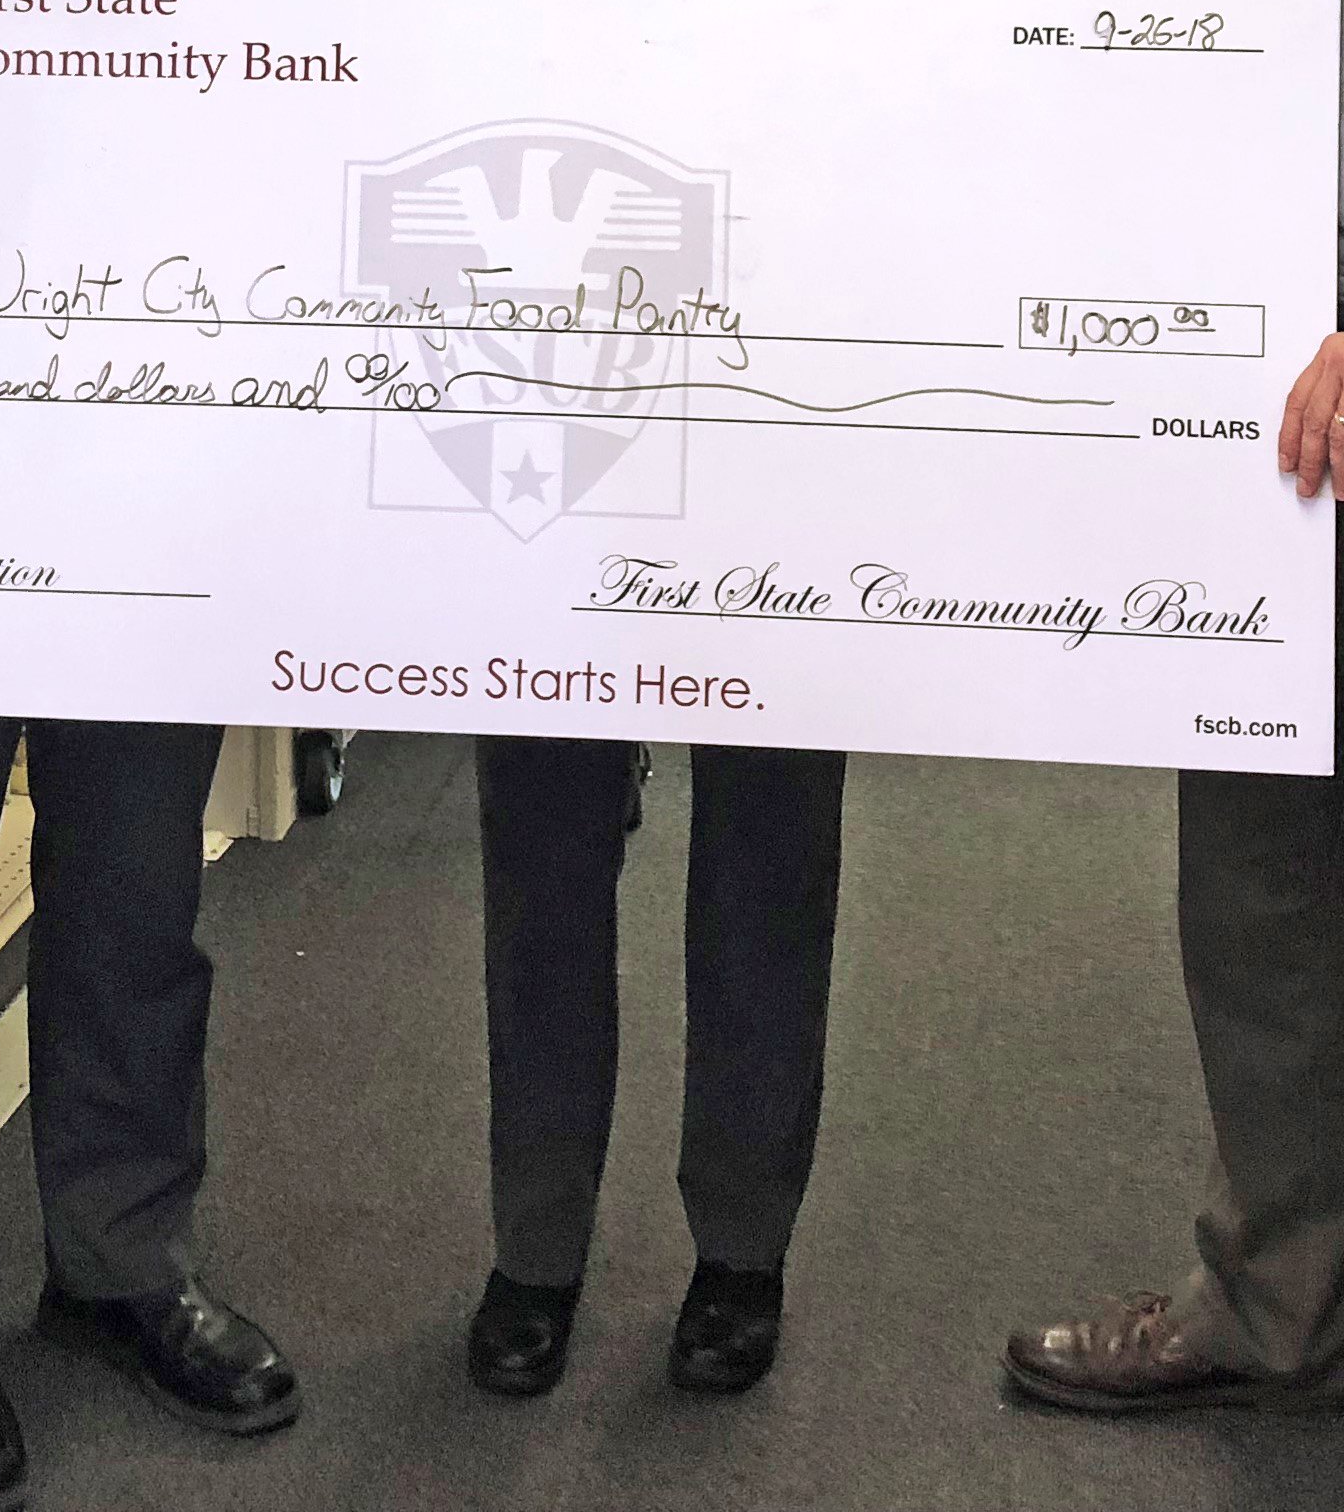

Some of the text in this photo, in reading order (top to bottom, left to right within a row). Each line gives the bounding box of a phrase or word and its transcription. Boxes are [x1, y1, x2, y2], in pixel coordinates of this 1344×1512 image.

[242, 42, 359, 83] Bank
[1012, 26, 1075, 47] DATE:
[142, 255, 223, 338] City
[461, 265, 588, 331] Food
[613, 265, 752, 371] Pantry
[73, 359, 218, 406] dollars
[231, 355, 330, 413] and
[436, 310, 648, 414] FSCB
[1151, 416, 1261, 441] DOLLARS
[588, 553, 1269, 652] First State Community Bank
[271, 649, 766, 711] Success Starts Here.
[1193, 714, 1299, 740] fscb.com
